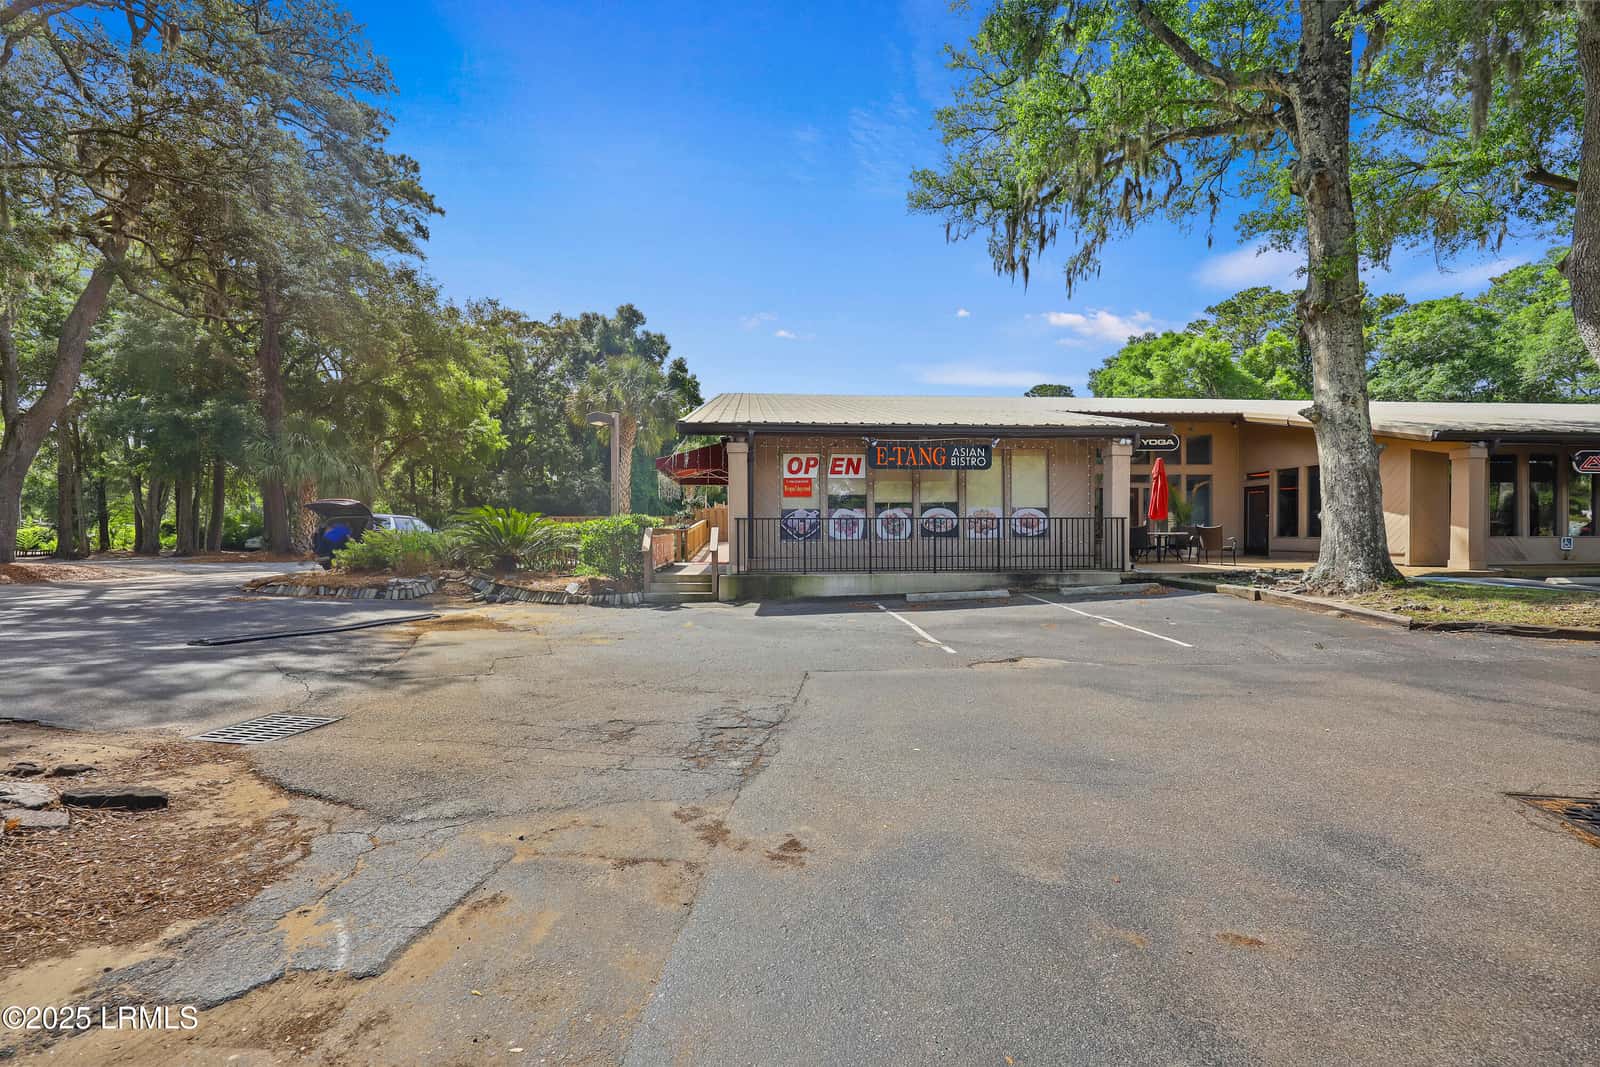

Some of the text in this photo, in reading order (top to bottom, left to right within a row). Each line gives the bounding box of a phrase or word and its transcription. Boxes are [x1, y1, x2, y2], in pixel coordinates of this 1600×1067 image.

[876, 446, 947, 466] E-TANG
[951, 447, 985, 457] ASIAN
[950, 457, 986, 466] BISTRO
